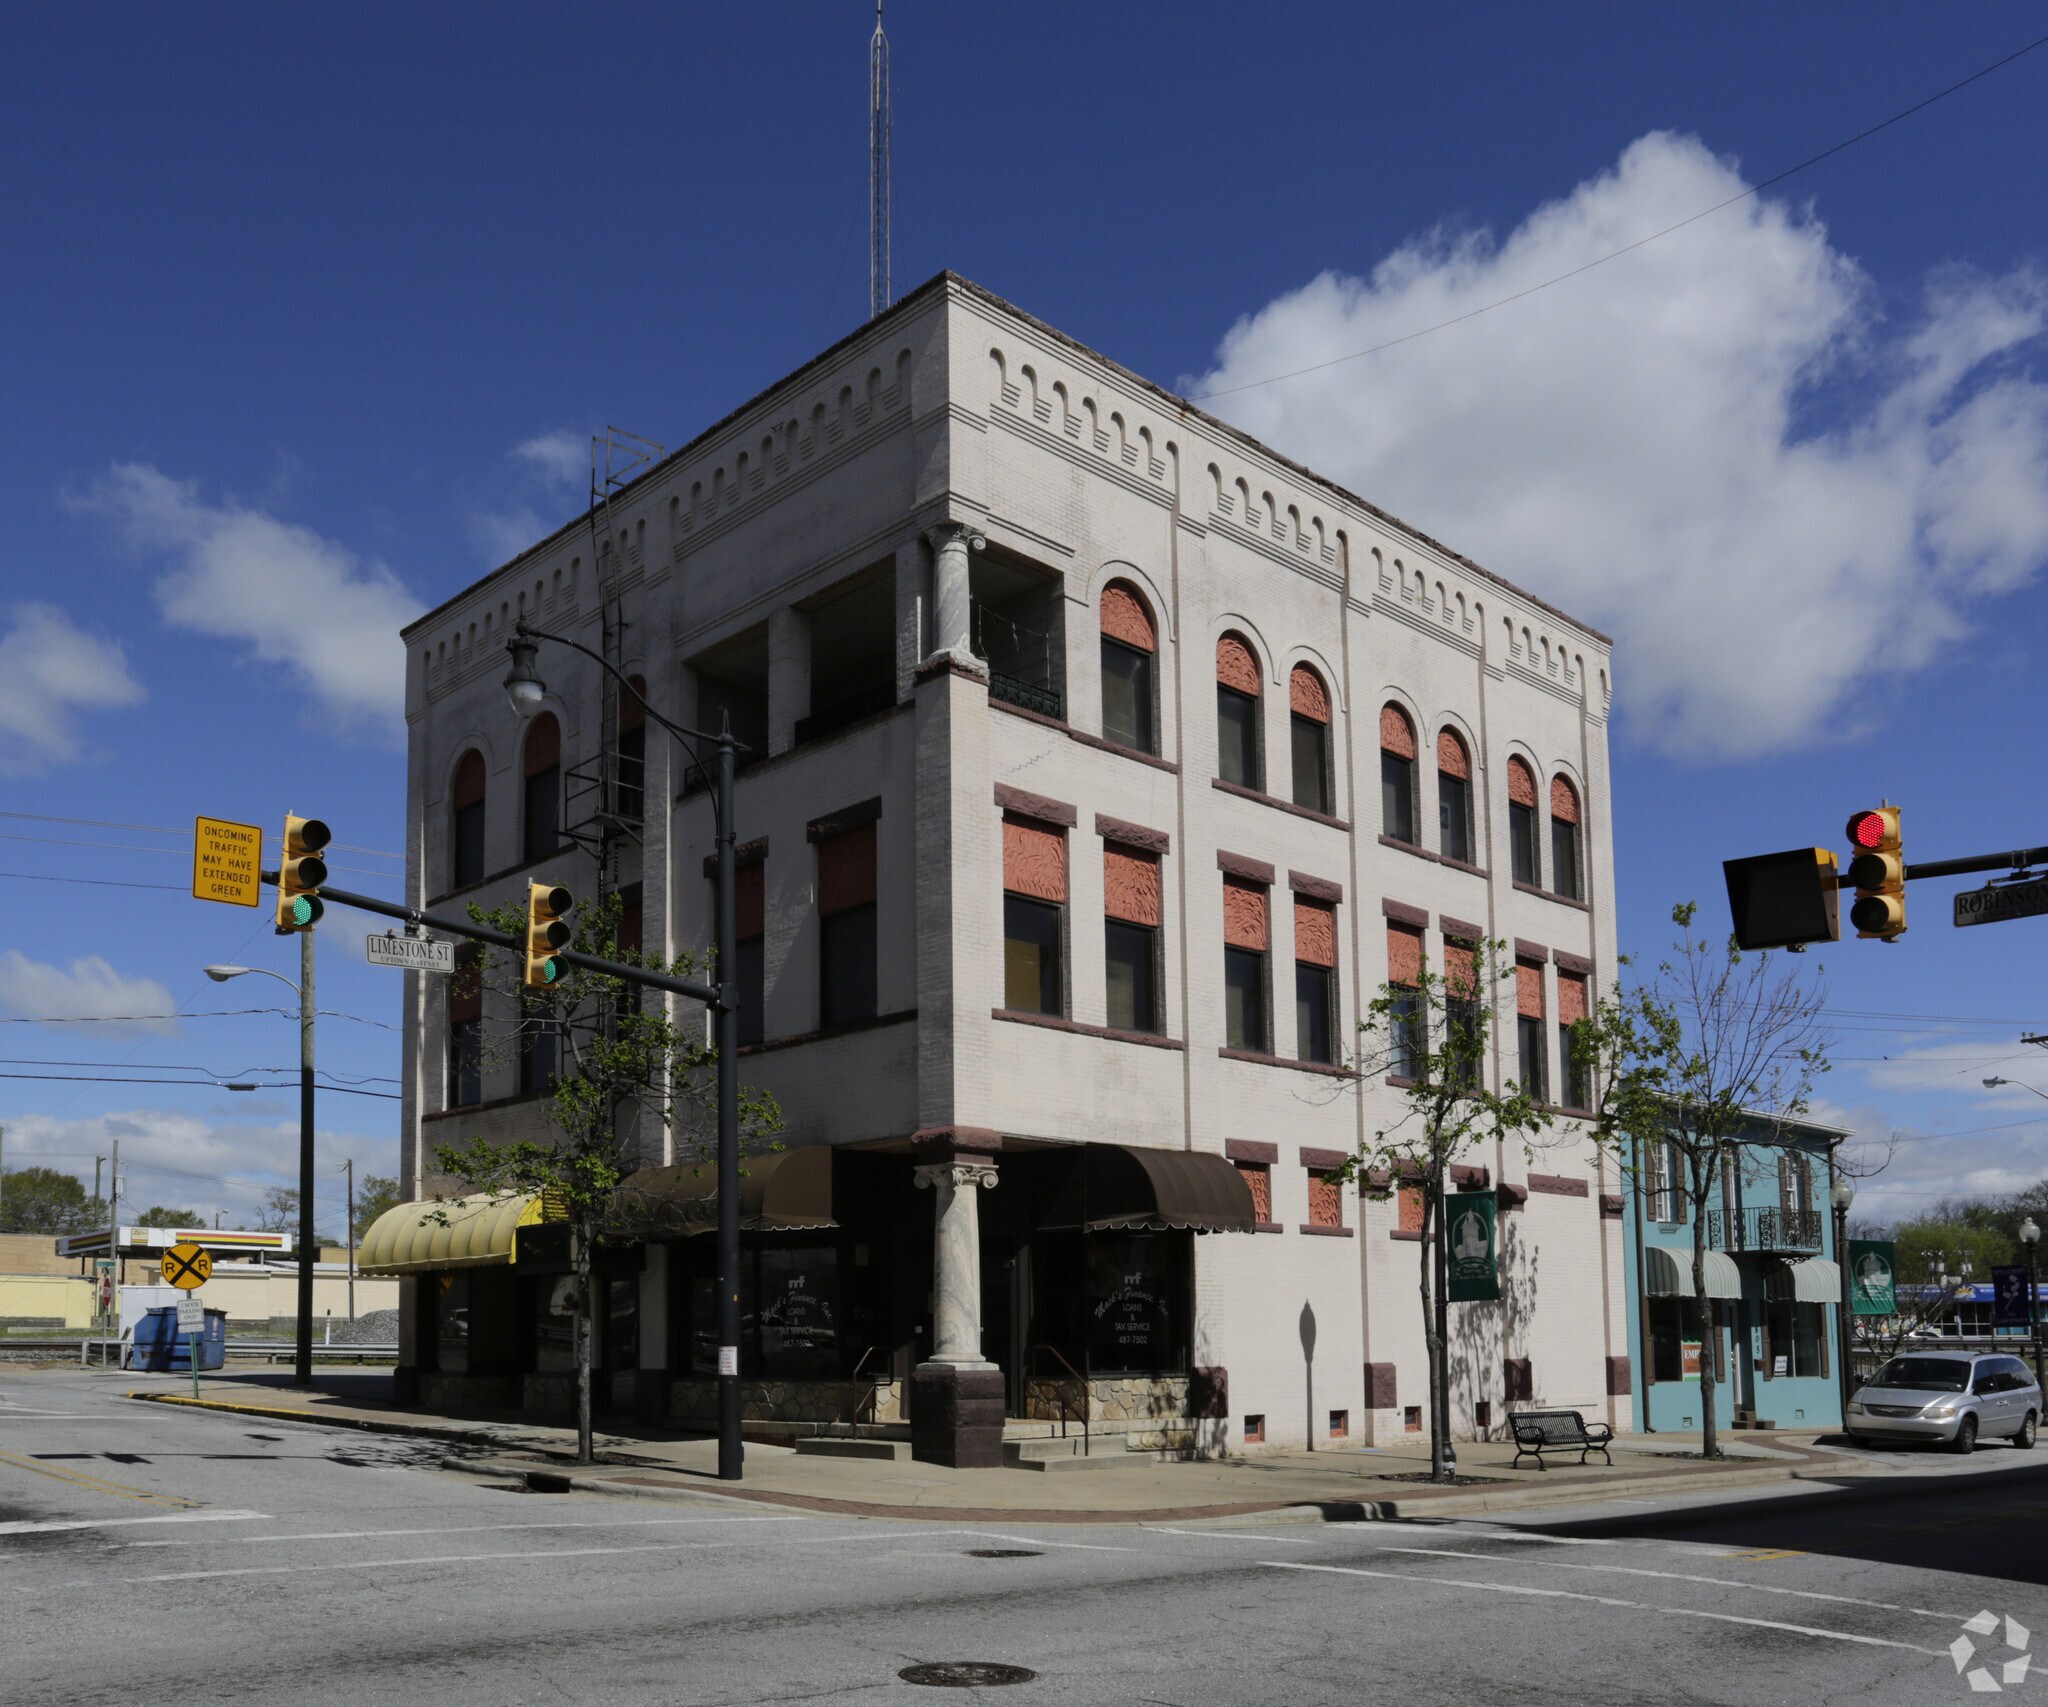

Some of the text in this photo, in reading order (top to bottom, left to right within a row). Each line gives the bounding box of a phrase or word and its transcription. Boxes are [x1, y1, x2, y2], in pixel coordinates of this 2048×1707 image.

[204, 826, 253, 843] ONCOMING
[209, 840, 248, 856] TRAFFIC
[202, 854, 252, 870] MAY HAVE
[203, 868, 250, 884] EXTENDED
[211, 884, 242, 896] GREEN
[370, 938, 450, 961] LIMESTONE ST
[380, 956, 410, 965] UPTOWN
[165, 1260, 208, 1274] R R
[1094, 1290, 1122, 1319] Mack's
[1122, 1304, 1142, 1312] LOANS
[787, 1307, 806, 1316] LOANS
[1115, 1322, 1150, 1331] TAX SERVICE
[1119, 1336, 1148, 1344] 487-7502
[1684, 1349, 1701, 1359] EMP
